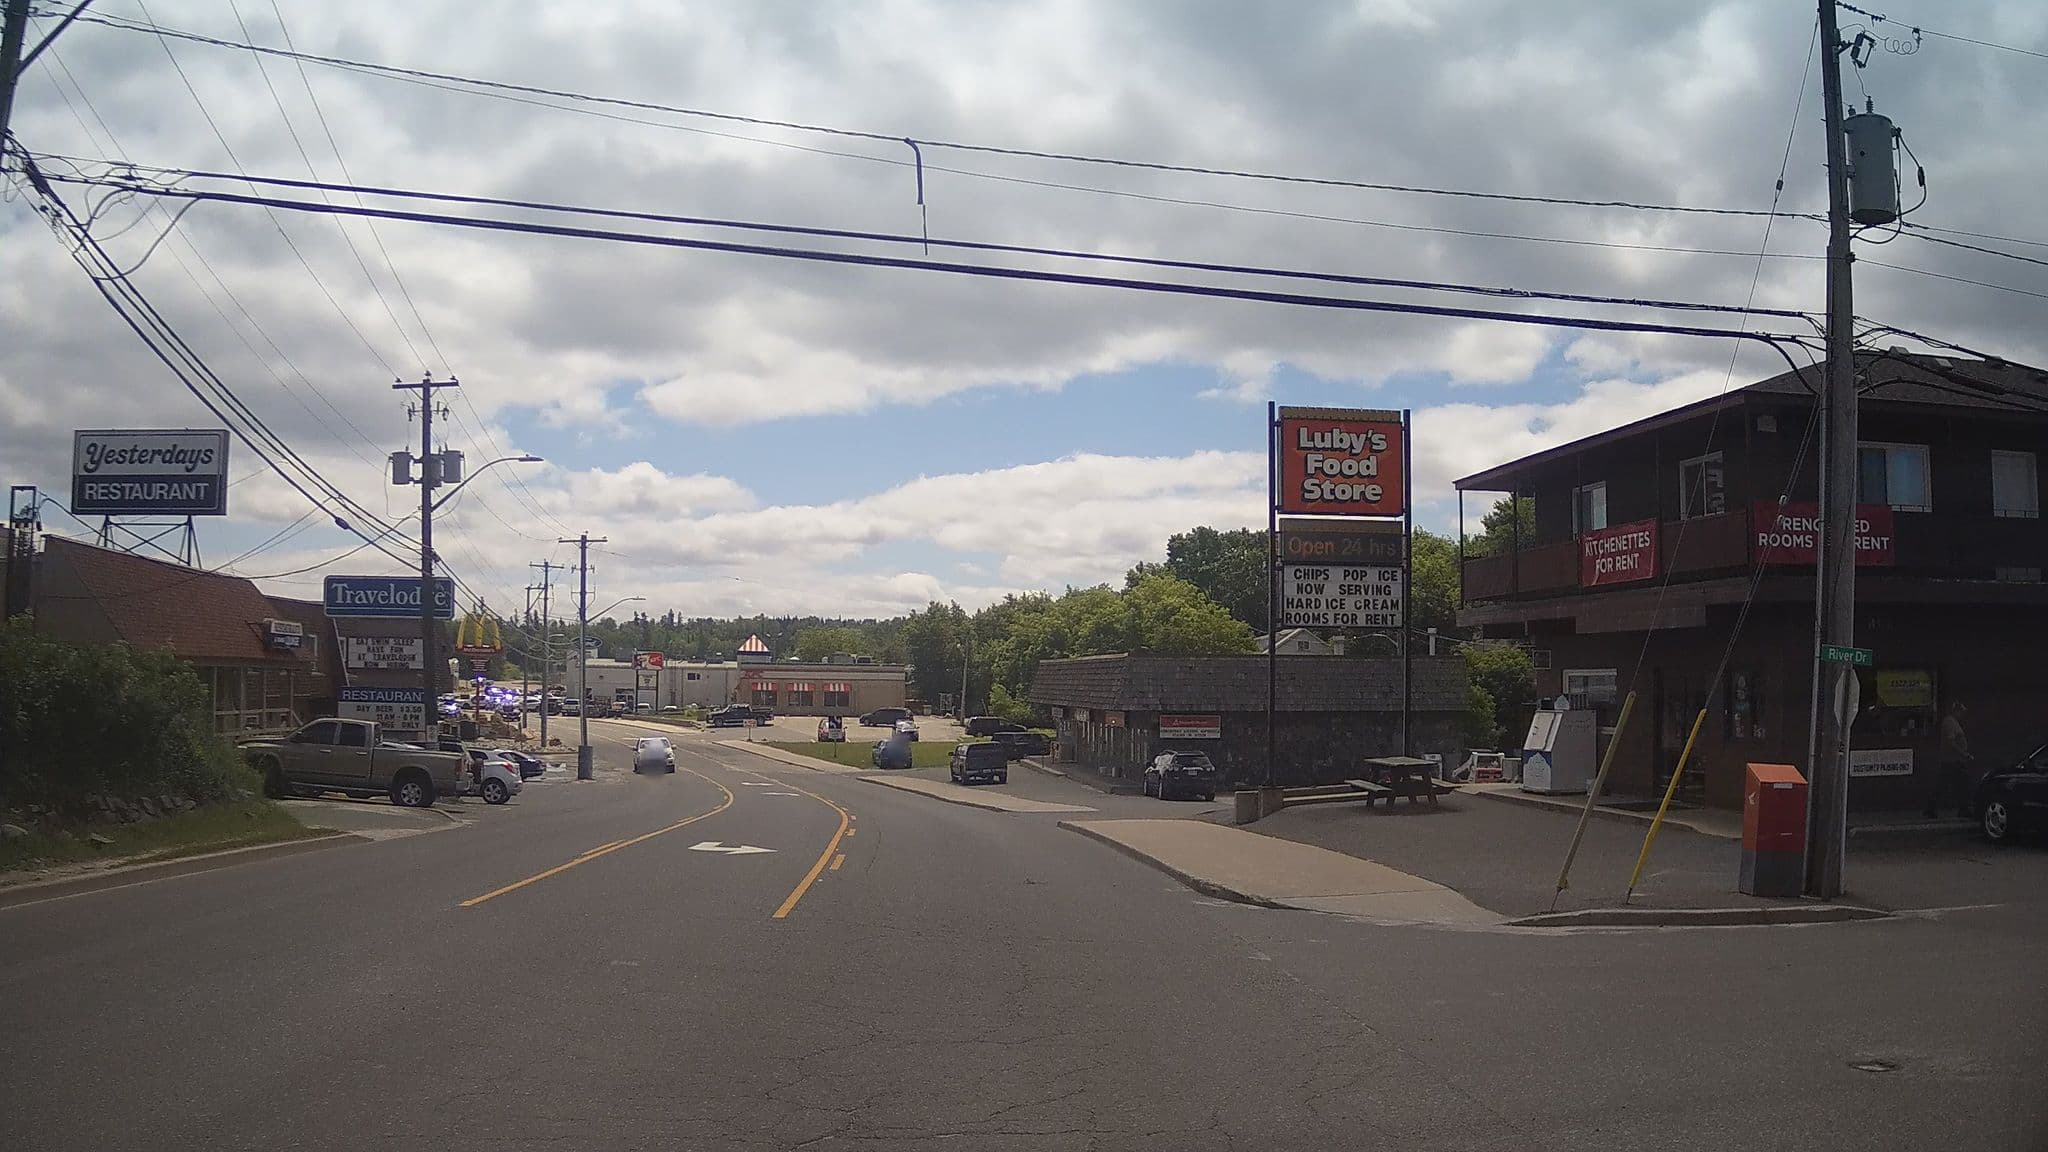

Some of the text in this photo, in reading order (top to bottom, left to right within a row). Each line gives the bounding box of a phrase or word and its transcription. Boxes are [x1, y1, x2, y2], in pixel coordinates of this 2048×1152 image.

[1299, 427, 1387, 454] Luby's
[83, 442, 214, 473] Yesterdays
[1306, 453, 1377, 477] Food
[84, 482, 209, 501] RESTAURANT
[1303, 478, 1383, 501] Store
[1288, 536, 1396, 558] Open 24 hrs
[1585, 530, 1650, 557] KITCHENETTES
[1758, 532, 1814, 549] ROOMS
[1595, 552, 1640, 574] FOR RENT
[1293, 568, 1398, 582] CHIPS POP ICE
[331, 582, 447, 606] Travelode
[1296, 582, 1392, 596] NOW SERVING
[1286, 597, 1399, 611] HARD ICE CREAM
[1285, 612, 1396, 626] ROOMS FOR RENT
[1829, 648, 1867, 663] River Dr
